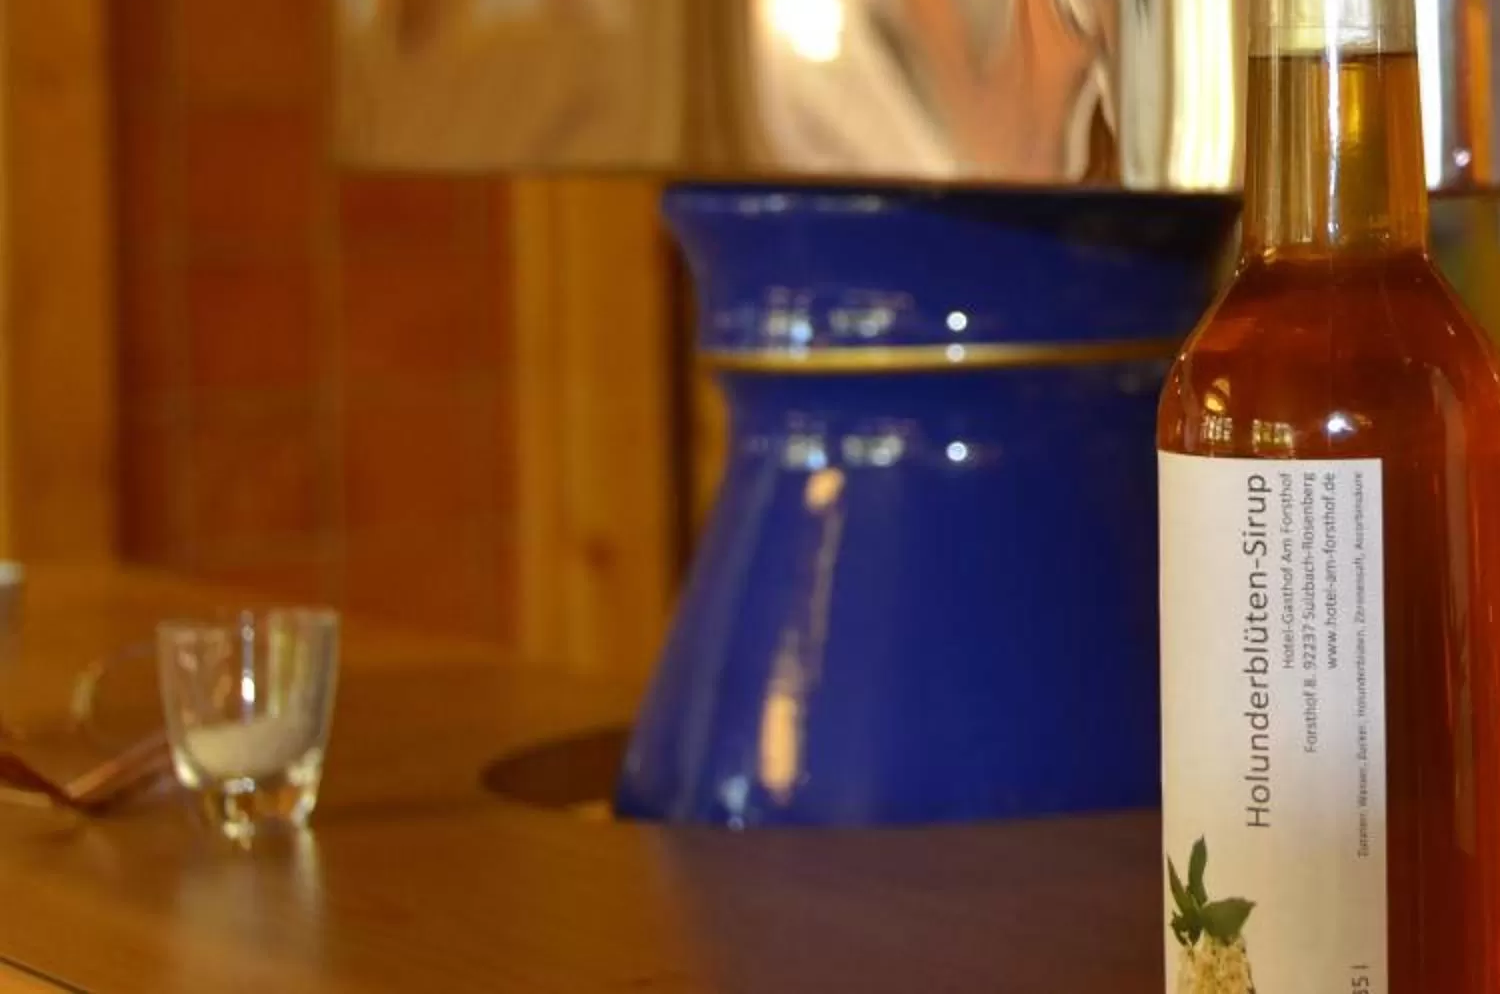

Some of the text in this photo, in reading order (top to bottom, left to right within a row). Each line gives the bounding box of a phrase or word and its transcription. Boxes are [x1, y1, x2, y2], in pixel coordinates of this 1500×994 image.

[1278, 473, 1295, 669] Hotel-Gasthof Am Forsthof
[1300, 472, 1316, 620] Sulzbach-Rosenberg
[1321, 472, 1337, 669] www.hotel-am-forsthof.de
[1241, 474, 1271, 828] Holunderblüten-Sirup
[1302, 624, 1316, 670] 92237
[1302, 691, 1317, 753] Forsthof
